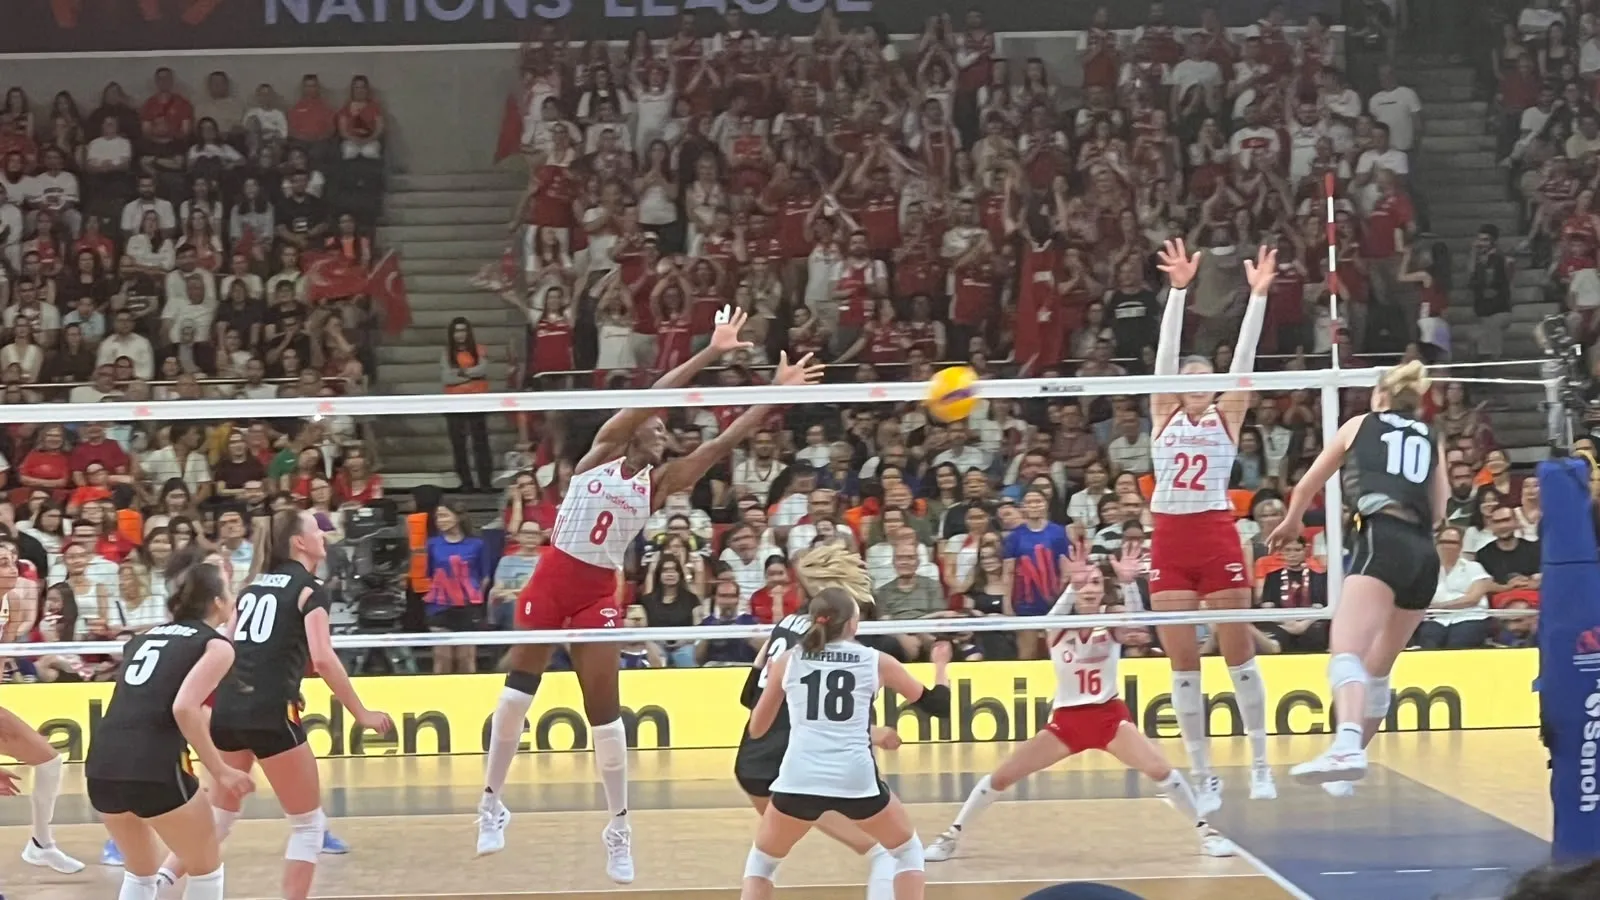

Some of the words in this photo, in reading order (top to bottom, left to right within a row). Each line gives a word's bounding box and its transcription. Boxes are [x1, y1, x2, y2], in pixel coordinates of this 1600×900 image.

[1173, 452, 1208, 491] 22
[1380, 429, 1431, 484] 10
[589, 511, 614, 545] 8
[233, 592, 277, 643] 20
[124, 639, 169, 686] 5
[1074, 669, 1102, 695] 16
[799, 669, 856, 722] 18
